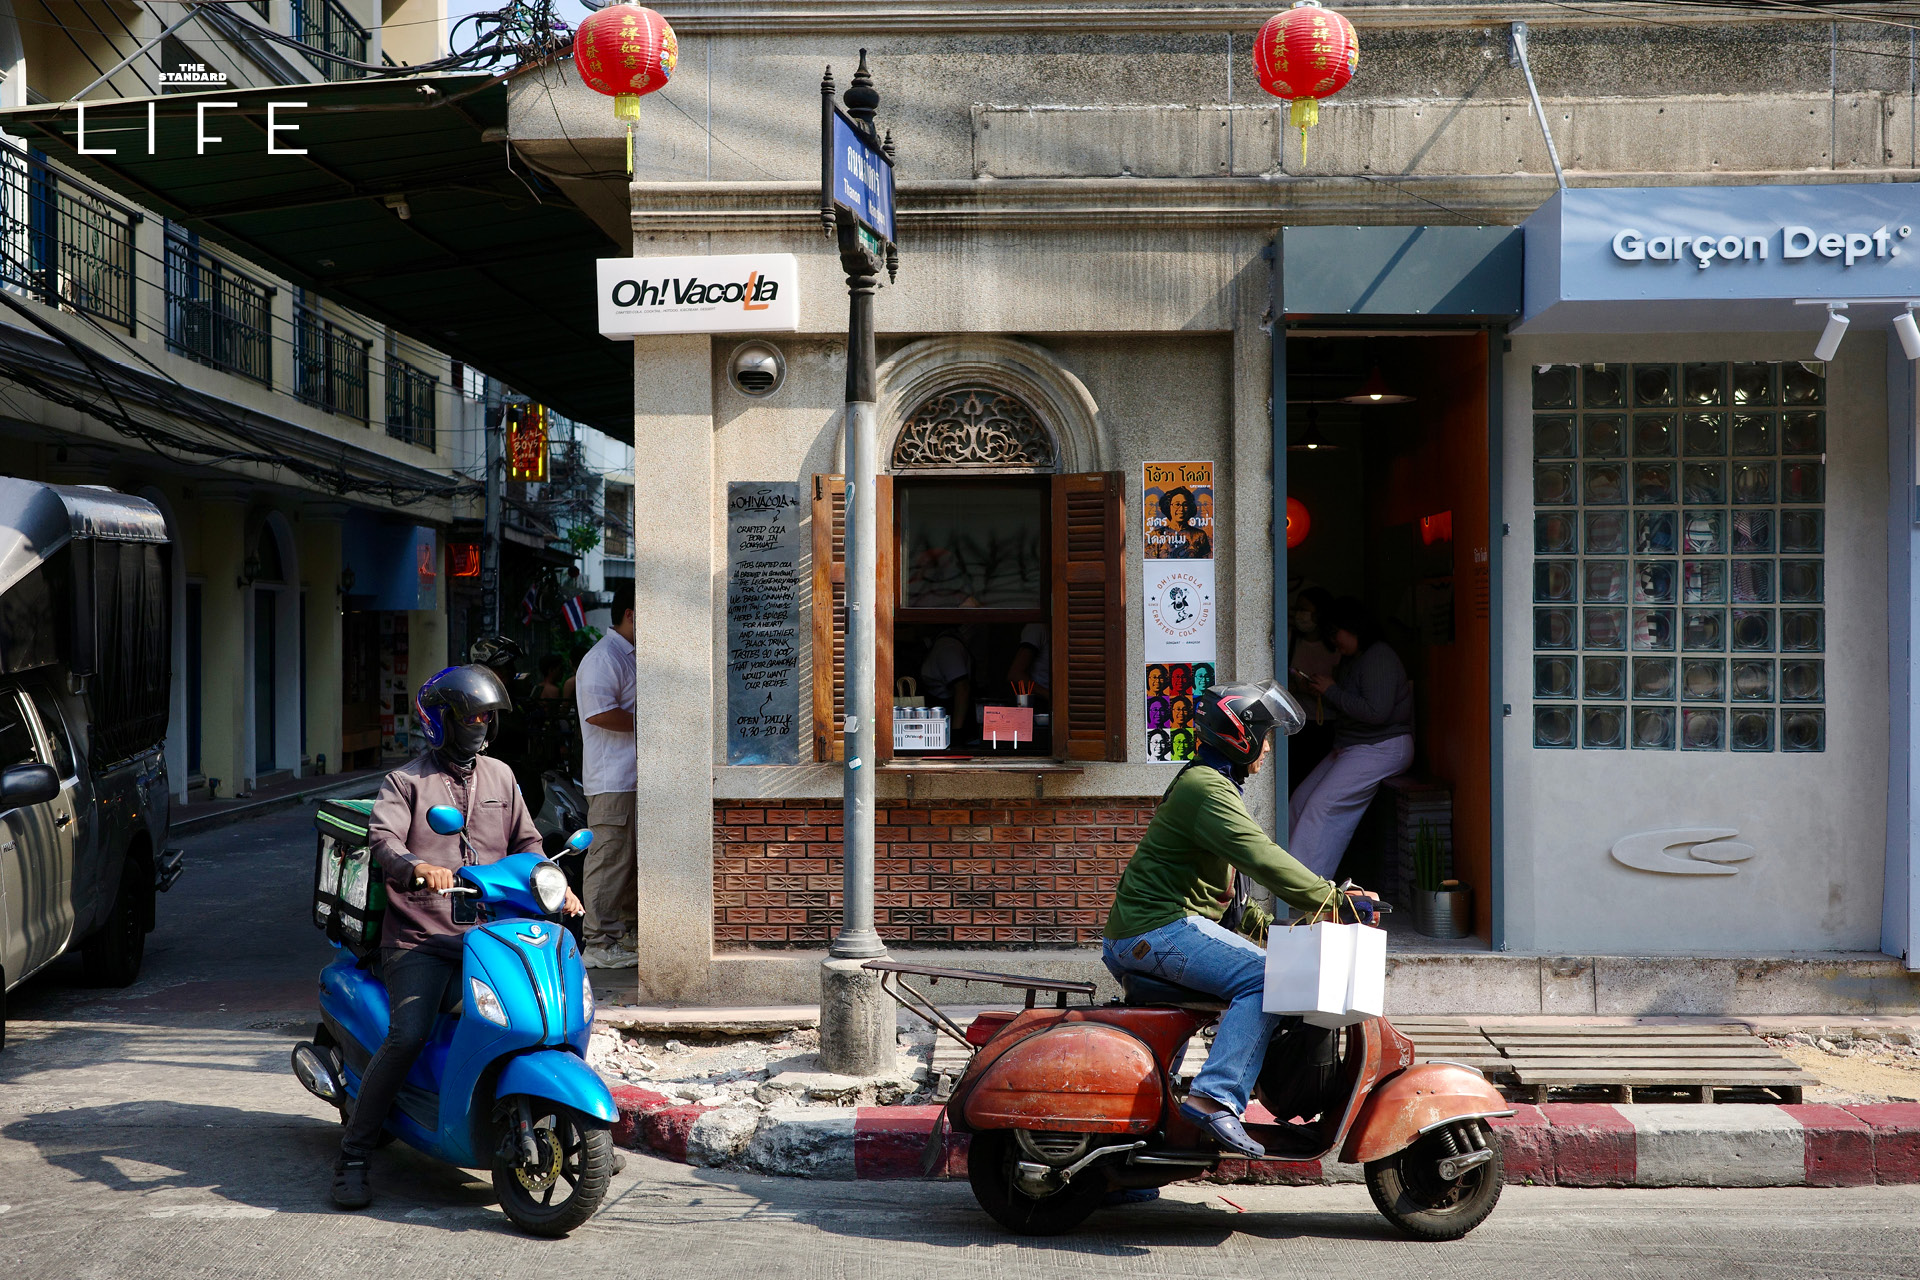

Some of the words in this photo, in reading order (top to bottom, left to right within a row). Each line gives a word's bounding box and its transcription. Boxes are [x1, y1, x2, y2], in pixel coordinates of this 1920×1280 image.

[619, 14, 641, 70] 吉祥如意
[1310, 16, 1333, 70] 吉祥如意
[843, 177, 861, 206] Thanon
[1612, 228, 1769, 270] Garçon
[1782, 224, 1901, 266] Dept.
[514, 439, 538, 453] BOYS
[1145, 465, 1174, 482] โอ้วา
[1178, 465, 1211, 482] โคล่า
[737, 525, 766, 534] CRAFTED
[769, 525, 786, 534] COLA
[747, 534, 764, 542] BORN
[766, 534, 778, 542] IN
[736, 560, 754, 569] THIS
[755, 560, 779, 569] CRAFTED
[752, 578, 786, 586] LEGENDARY
[1157, 573, 1203, 590] OH!VACOLA
[733, 614, 752, 622] HERB
[763, 610, 788, 621] SPICES
[743, 621, 756, 629] FOR
[762, 620, 784, 628] HEARTY
[1152, 609, 1175, 636] CRAFTED
[1178, 627, 1197, 637] COLA
[1198, 608, 1209, 627] CLUB
[739, 630, 754, 639] AND
[756, 628, 794, 637] HEALTHIER
[741, 639, 766, 649] BLACK
[768, 638, 790, 648] DRINK
[731, 649, 759, 659] TASTES
[762, 649, 772, 659] SO
[774, 647, 794, 658] GOOD
[728, 661, 749, 673] THAT
[750, 661, 766, 672] YOUR
[742, 671, 766, 681] WOULD
[767, 669, 791, 678] WANT
[745, 682, 760, 690] OUR
